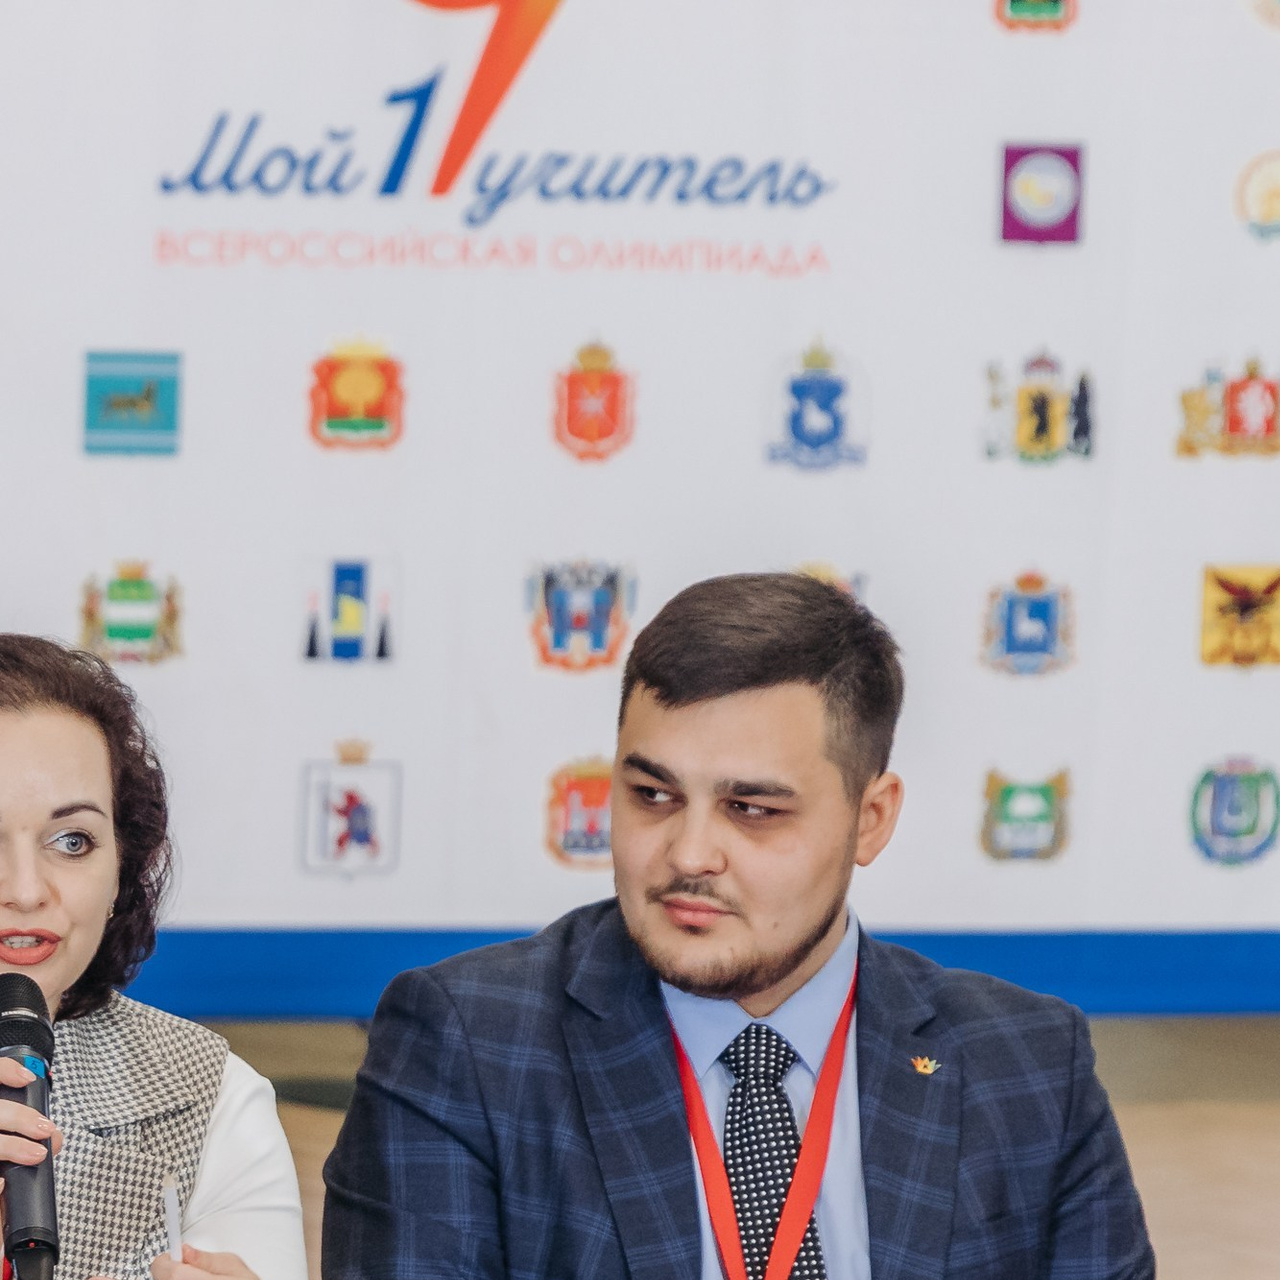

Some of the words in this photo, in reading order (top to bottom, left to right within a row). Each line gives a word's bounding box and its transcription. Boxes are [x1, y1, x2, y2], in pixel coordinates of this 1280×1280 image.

[158, 108, 365, 197] Мой
[463, 150, 833, 228] учитель
[153, 227, 537, 268] ВСЕРОССИЙСКАЯ
[547, 233, 831, 279] ОЛИМПИАДА
